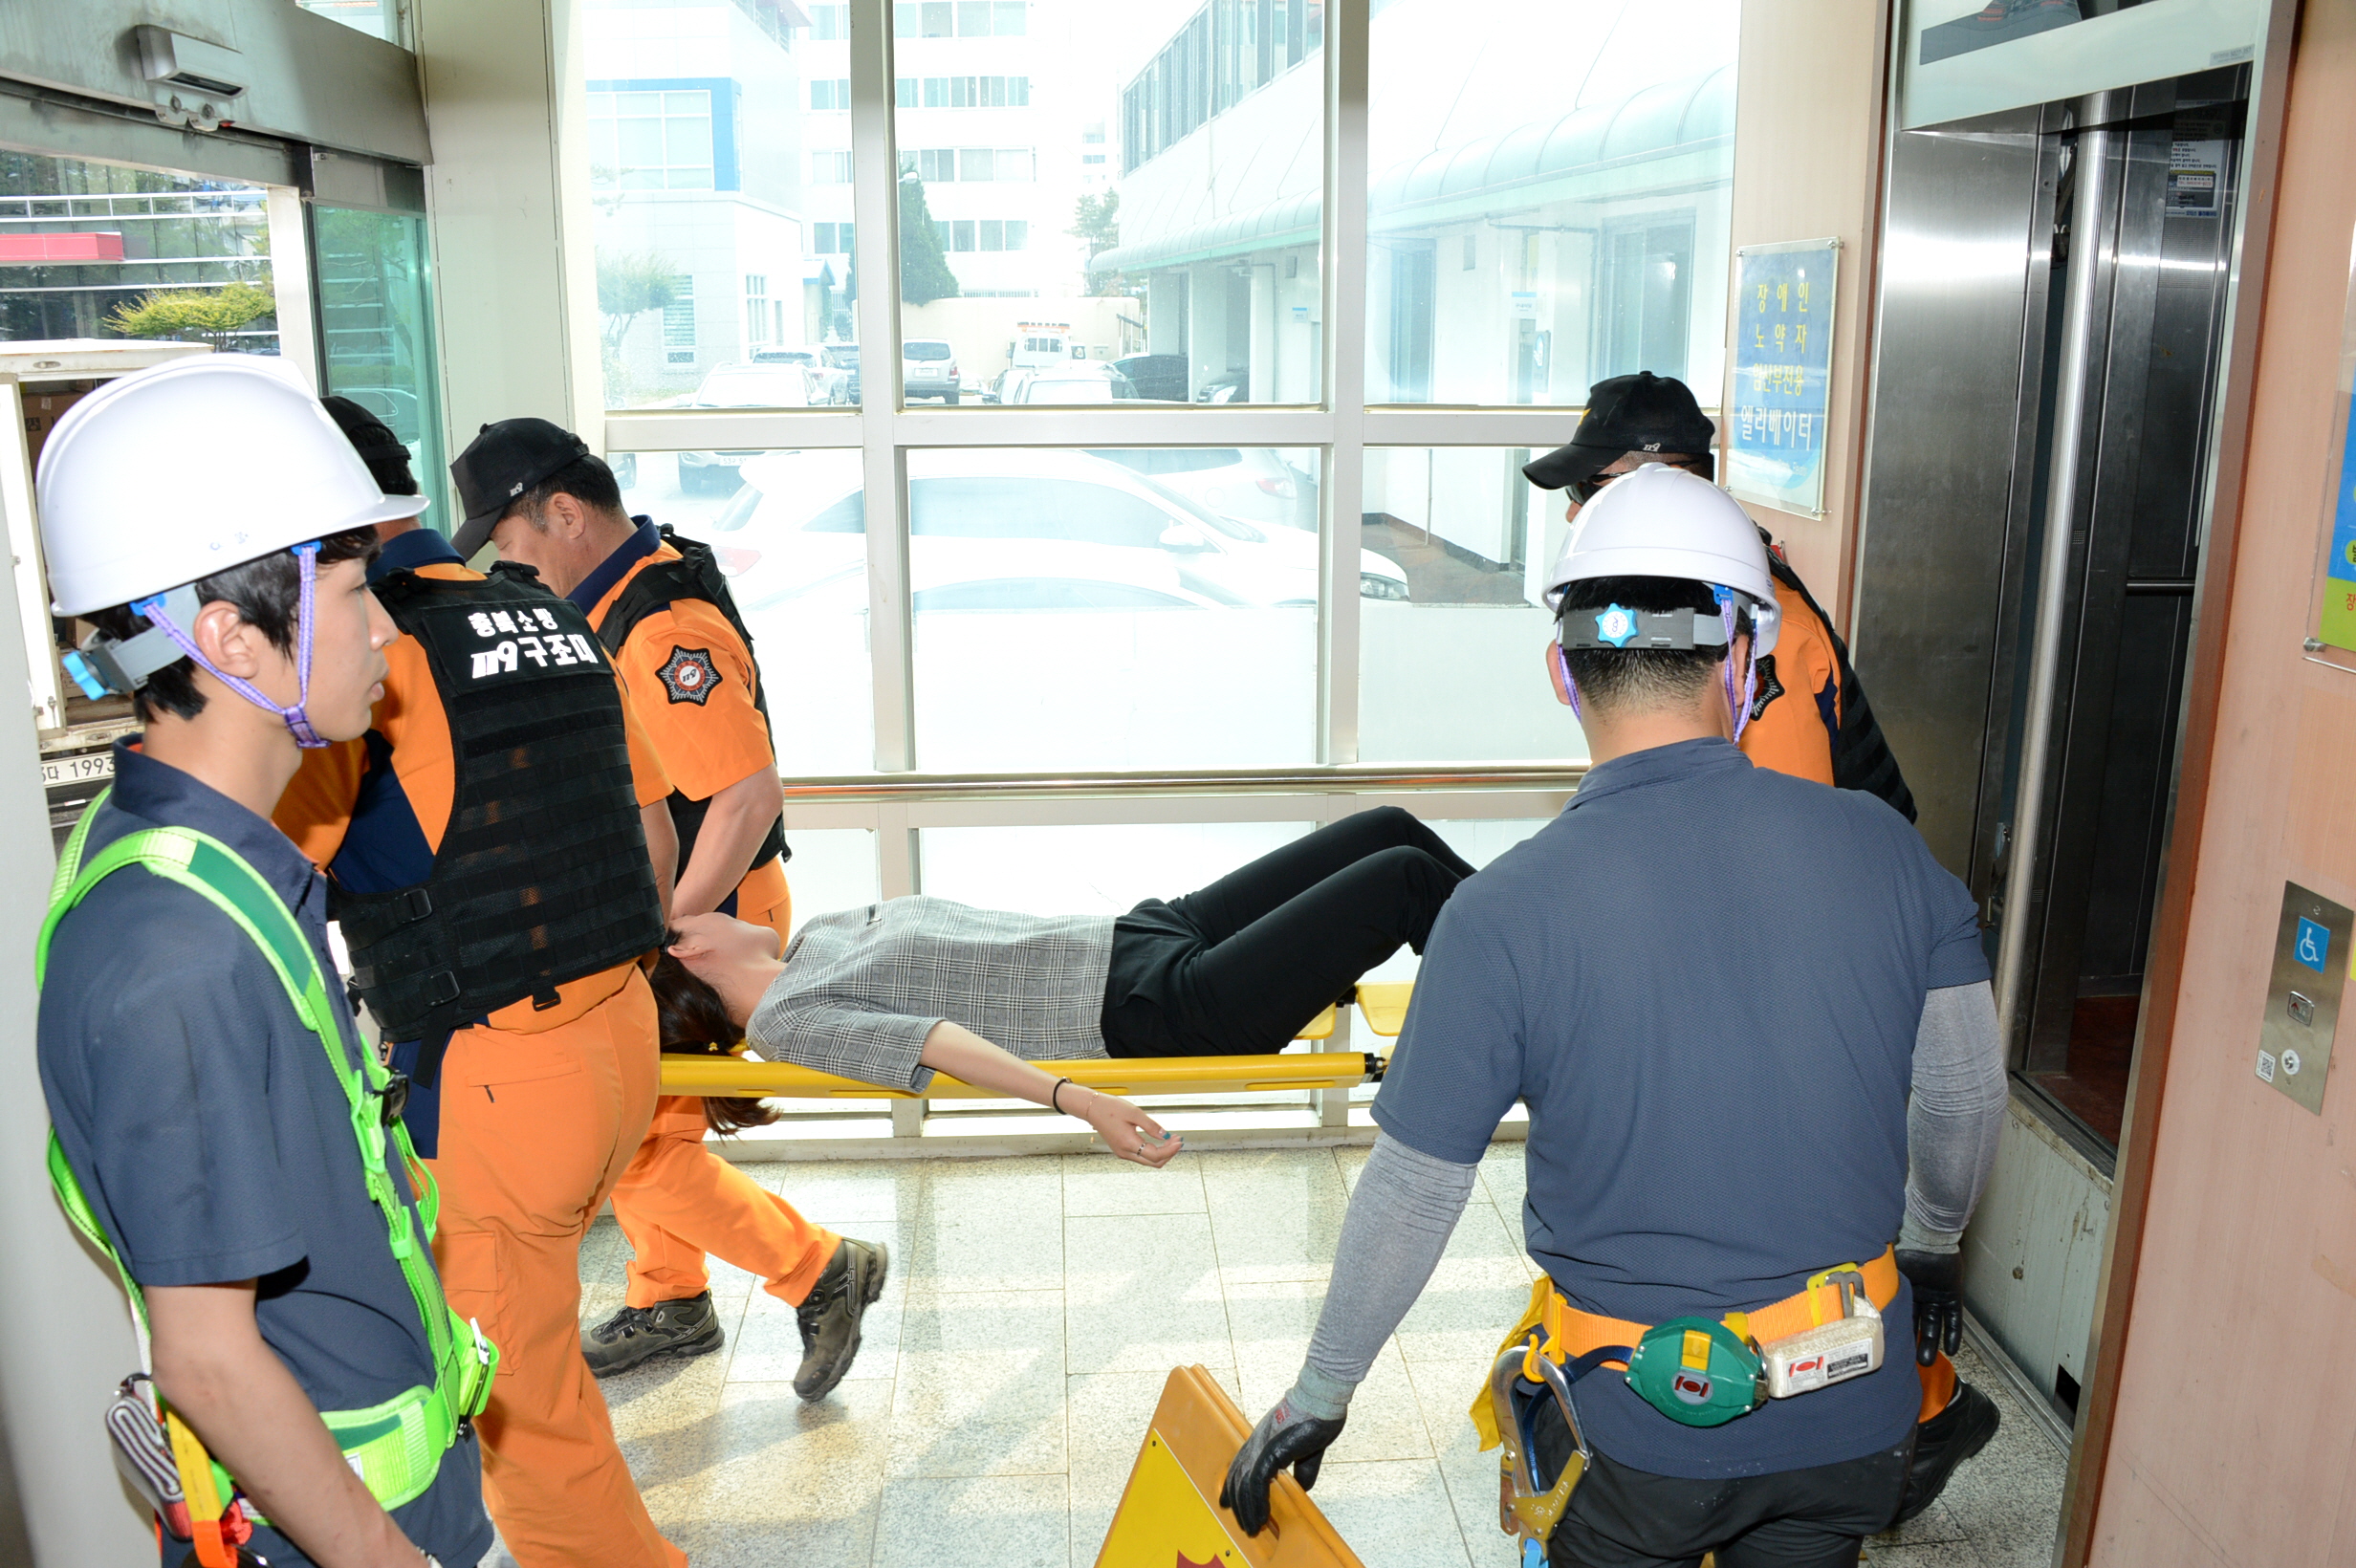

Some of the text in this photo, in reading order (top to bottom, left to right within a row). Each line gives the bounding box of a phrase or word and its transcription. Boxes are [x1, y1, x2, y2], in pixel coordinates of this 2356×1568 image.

[1757, 282, 1809, 313] 장애인
[1755, 323, 1807, 354] 노약자
[1753, 362, 1804, 396] 임산부전용
[1740, 403, 1812, 451] 엘리베이터
[468, 608, 558, 637] 충북소방
[470, 634, 599, 679] 119구조대
[69, 756, 115, 777] 1993
